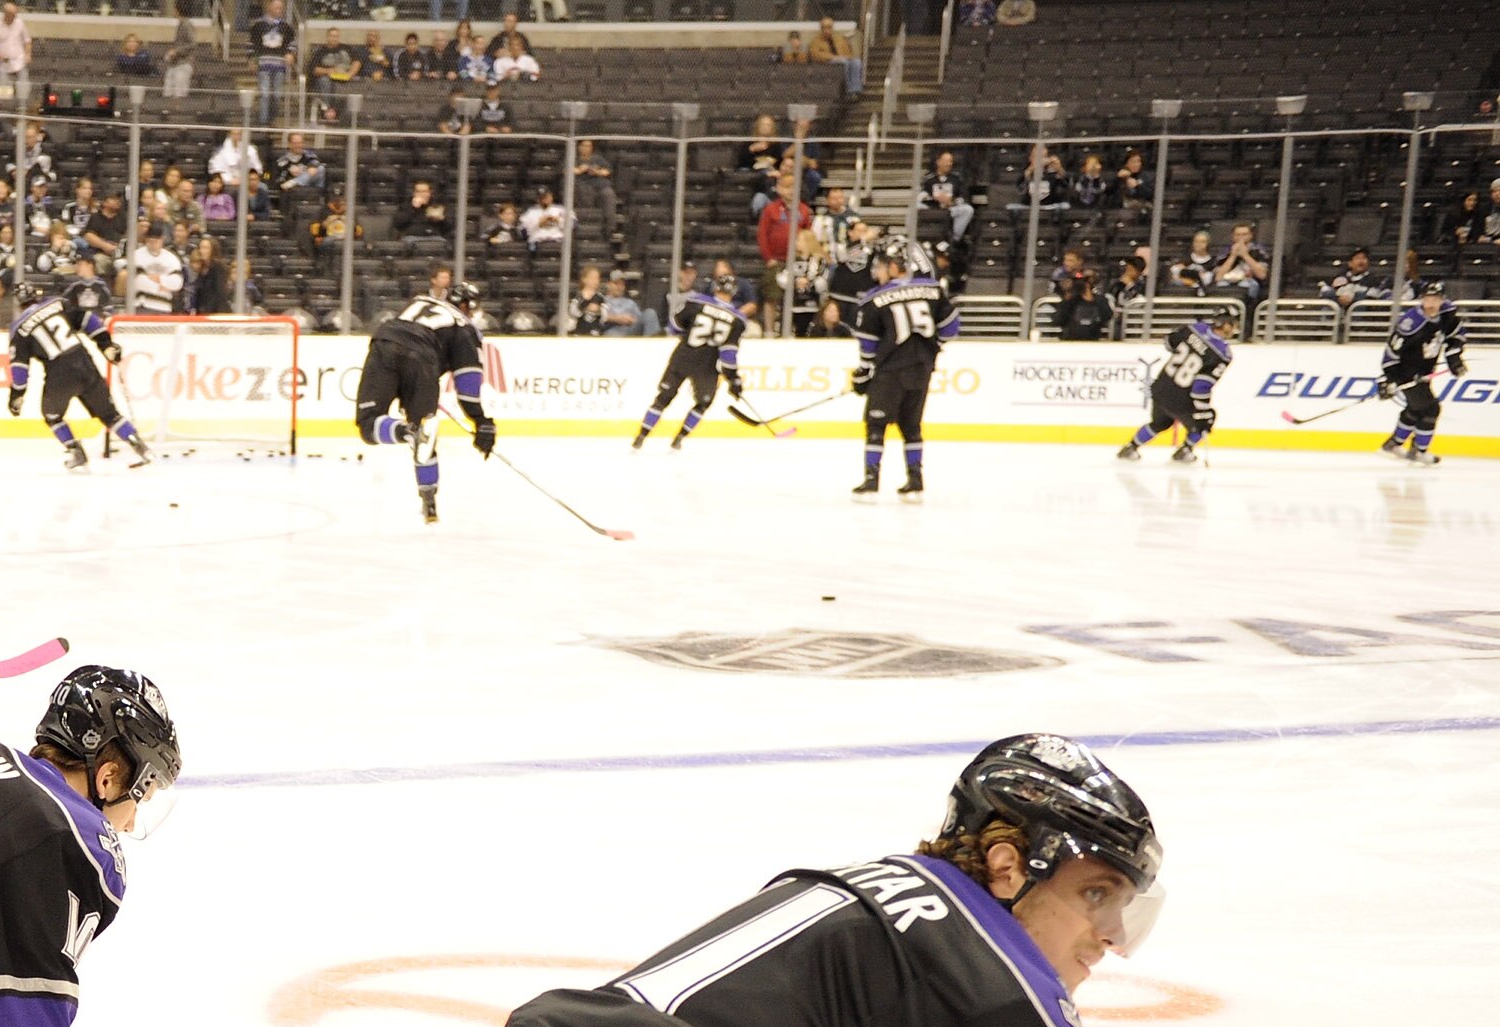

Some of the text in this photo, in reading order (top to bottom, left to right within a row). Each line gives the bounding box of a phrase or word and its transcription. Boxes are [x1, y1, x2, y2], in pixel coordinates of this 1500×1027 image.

[889, 300, 936, 345] 15
[30, 315, 81, 360] 12
[1013, 367, 1138, 381] HOCKEY FIGHTS
[1164, 341, 1203, 388] 28
[513, 377, 627, 395] MERCURY
[739, 366, 831, 392] ELLS
[1044, 385, 1107, 400] CANCER
[1256, 372, 1380, 400] BUD
